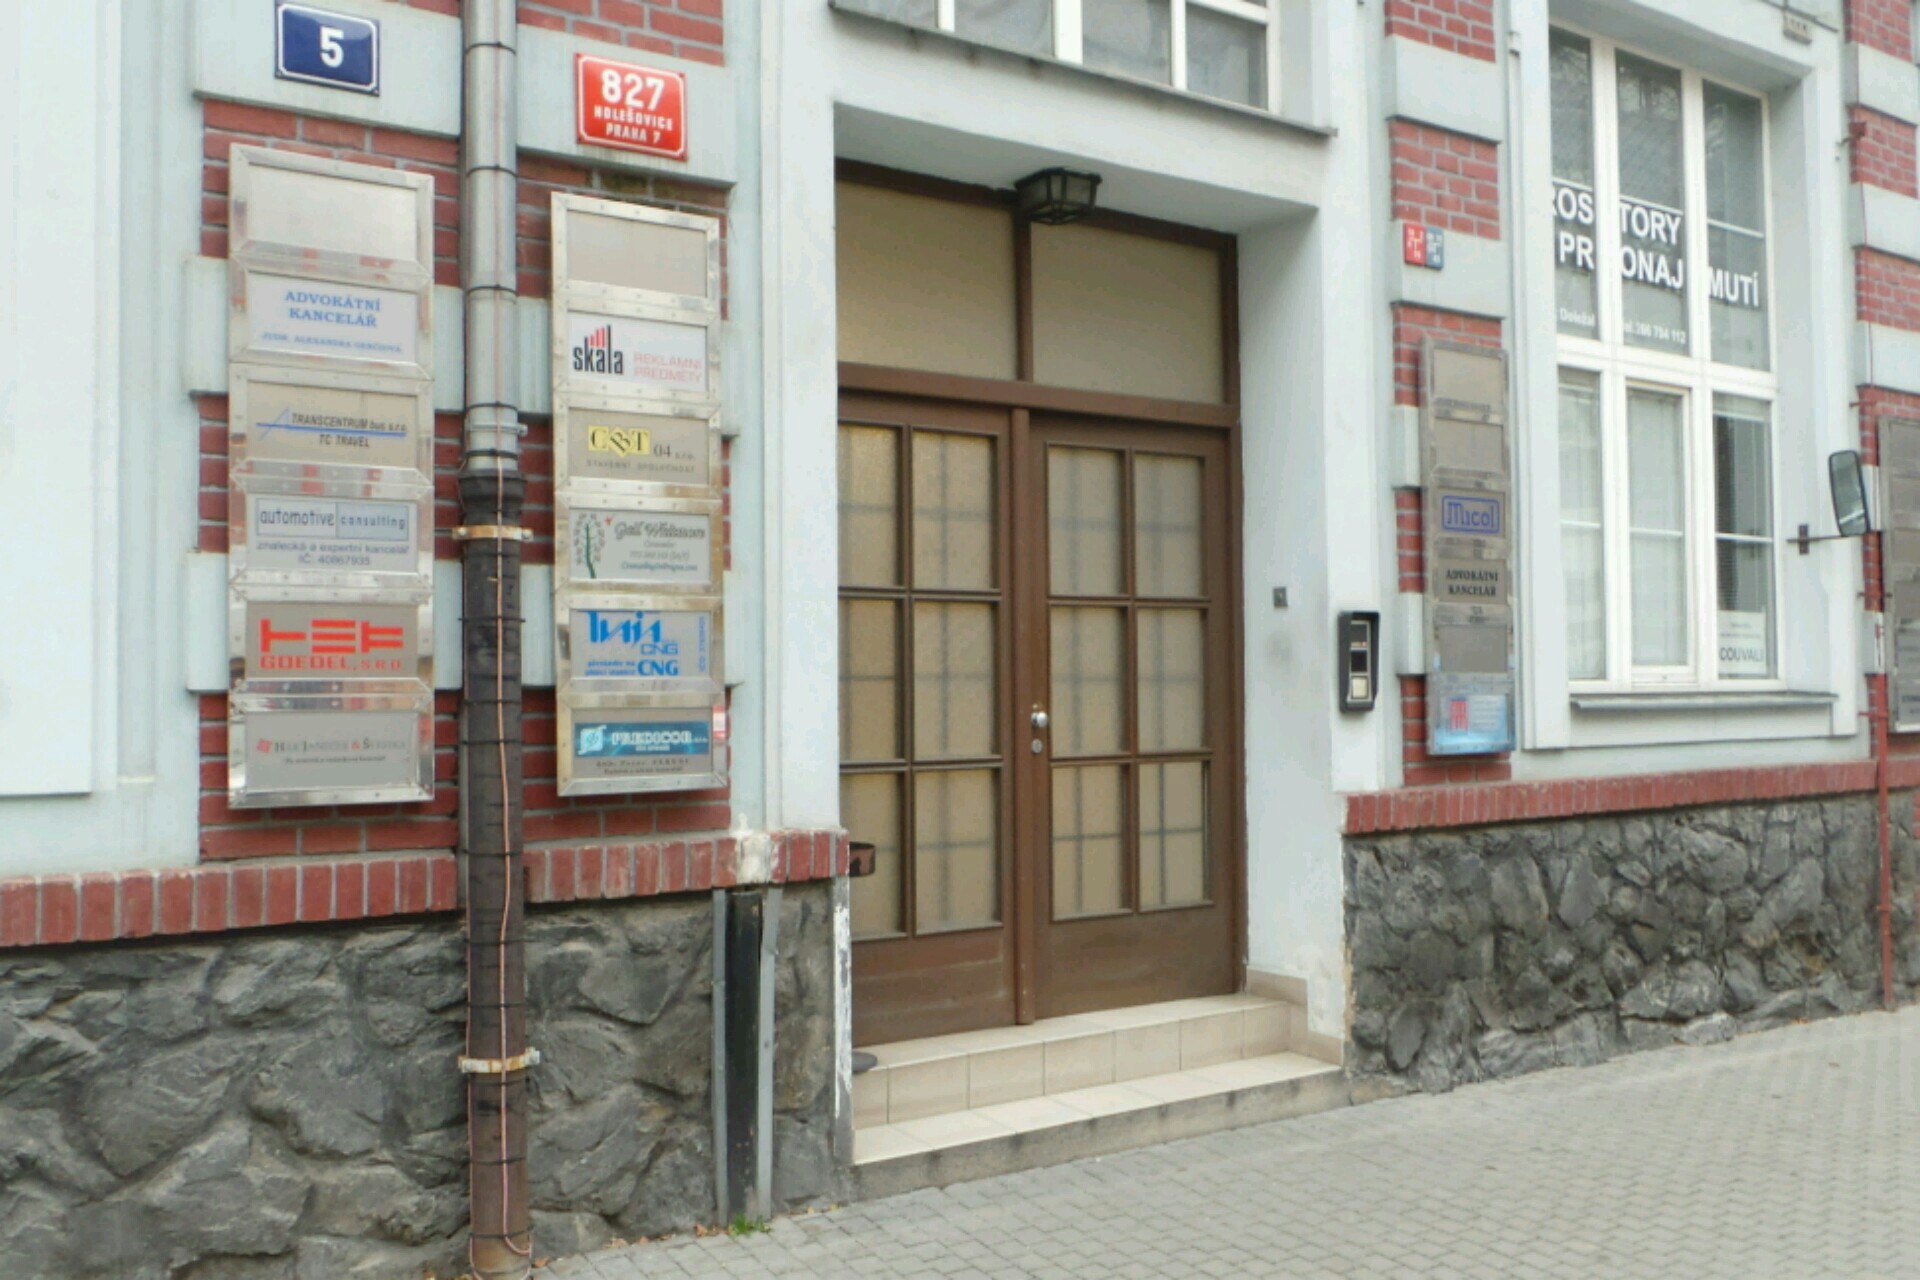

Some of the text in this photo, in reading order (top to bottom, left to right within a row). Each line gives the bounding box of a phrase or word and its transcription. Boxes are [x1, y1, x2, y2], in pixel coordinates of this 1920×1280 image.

[320, 26, 344, 68] 5
[602, 69, 664, 112] 827
[606, 122, 662, 144] PRAHA 7
[285, 290, 381, 312] ADVOKÁTNÍ
[573, 324, 624, 375] skala
[291, 413, 368, 429] TRANSCENTRUM
[335, 435, 371, 448] TRAVEL
[260, 508, 405, 530] automotive consulting
[637, 659, 679, 676] CNG
